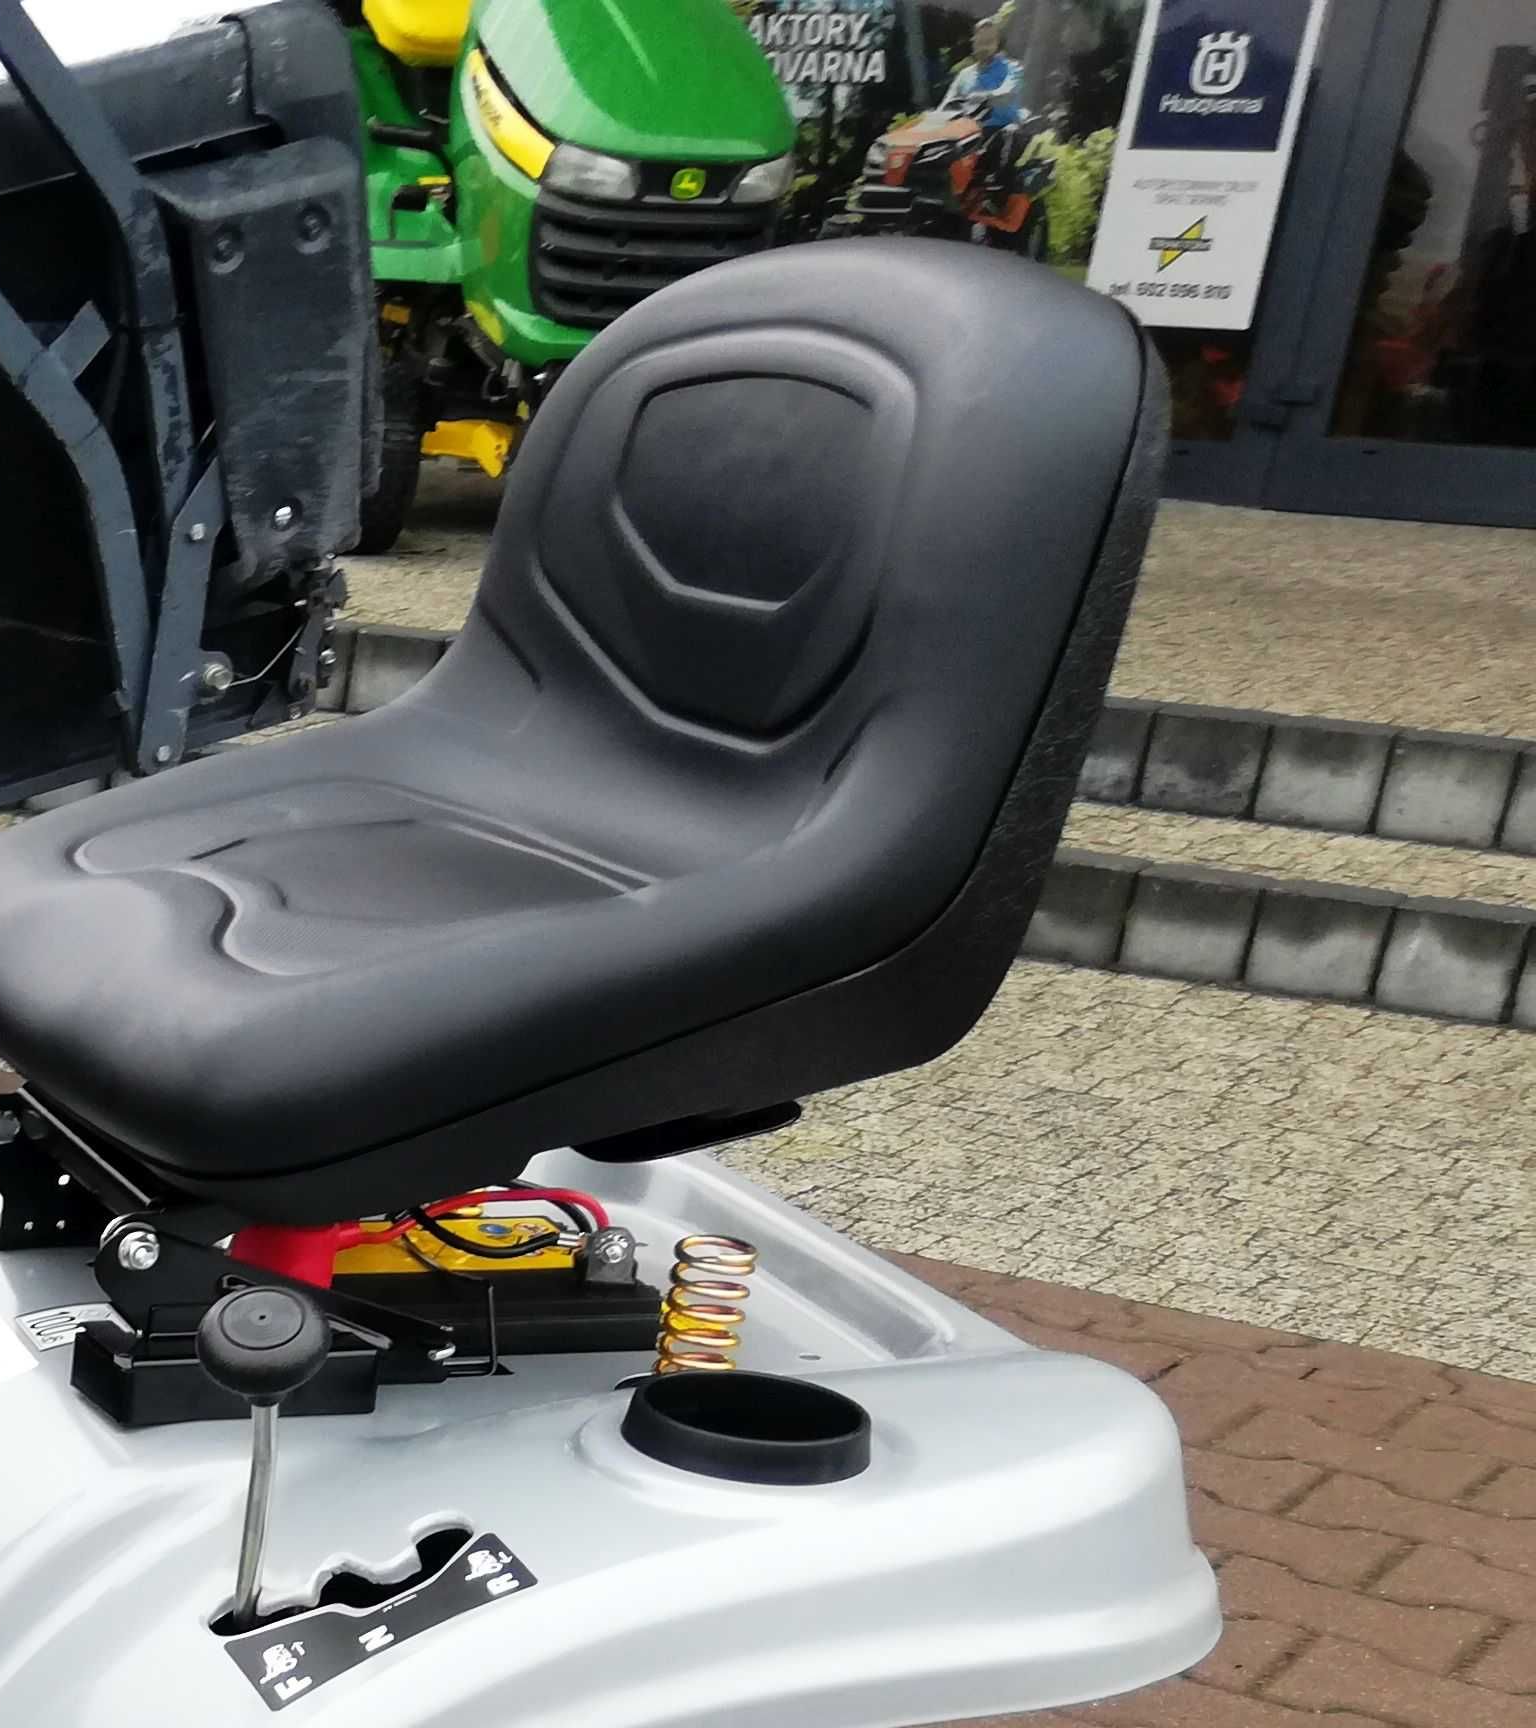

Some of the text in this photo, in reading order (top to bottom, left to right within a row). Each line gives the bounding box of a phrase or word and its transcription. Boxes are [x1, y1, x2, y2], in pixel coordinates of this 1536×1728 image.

[486, 1571, 521, 1596] R
[358, 1623, 395, 1653] N
[273, 1675, 313, 1701] F
